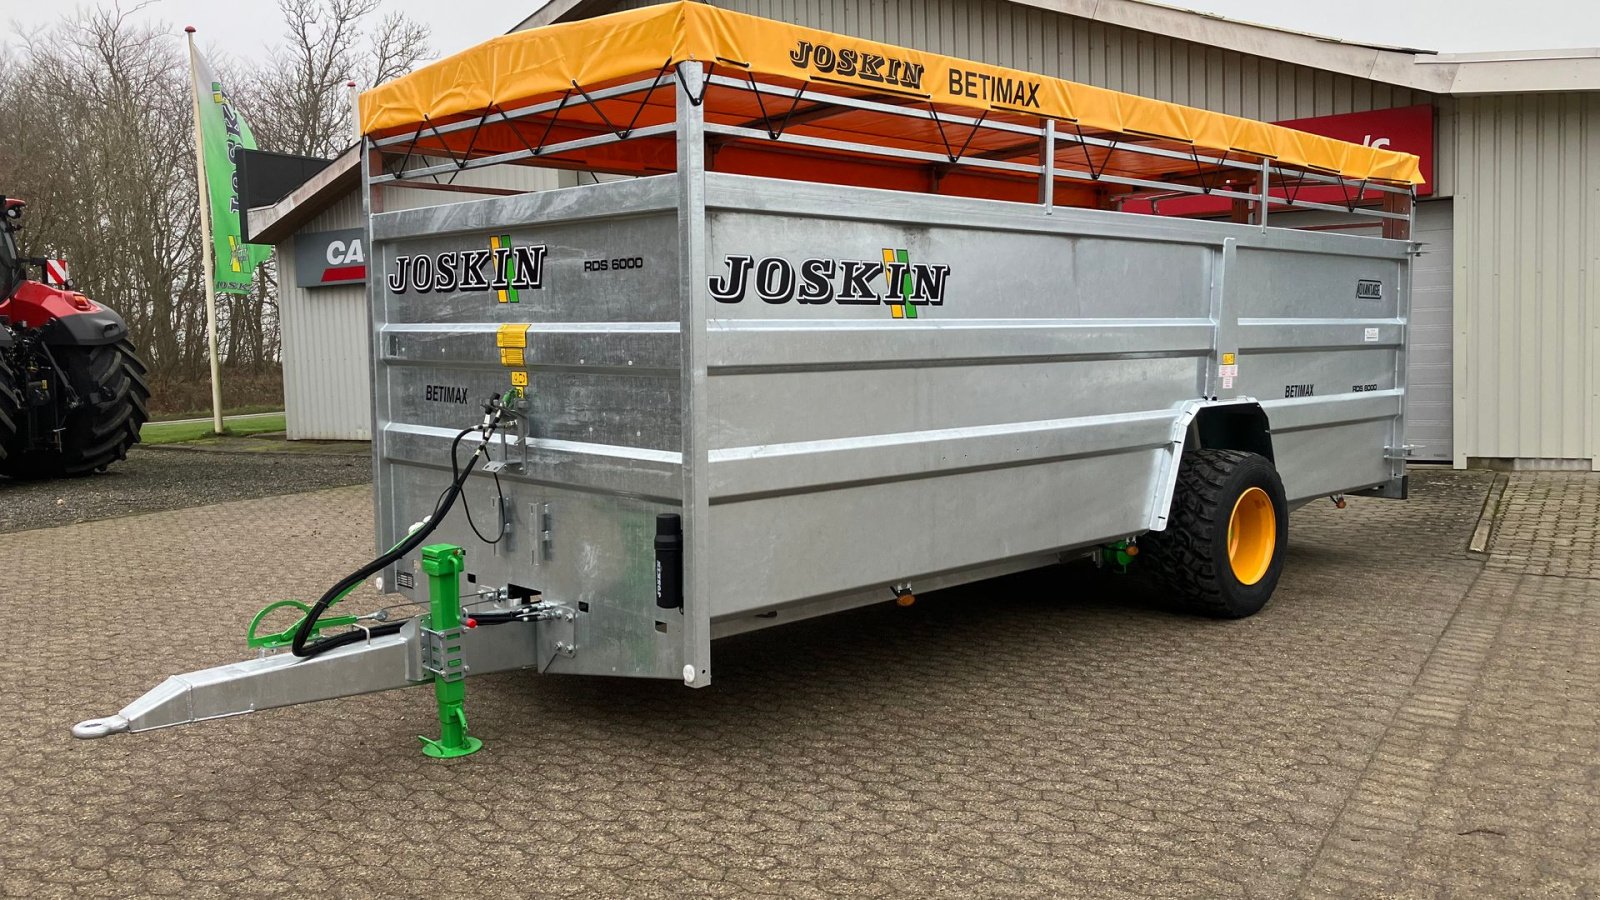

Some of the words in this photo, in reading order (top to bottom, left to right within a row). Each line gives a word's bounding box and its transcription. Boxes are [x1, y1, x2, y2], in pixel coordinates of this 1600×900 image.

[790, 41, 924, 90] JOSKIN
[949, 68, 1040, 109] BETIMAX
[326, 238, 366, 265] CA
[584, 260, 608, 272] RDS
[611, 257, 643, 270] 6000
[387, 244, 548, 294] JOSKIN
[707, 254, 950, 306] JOSKIN
[425, 384, 468, 405] BETIMAX
[1285, 384, 1314, 398] BETIMAX
